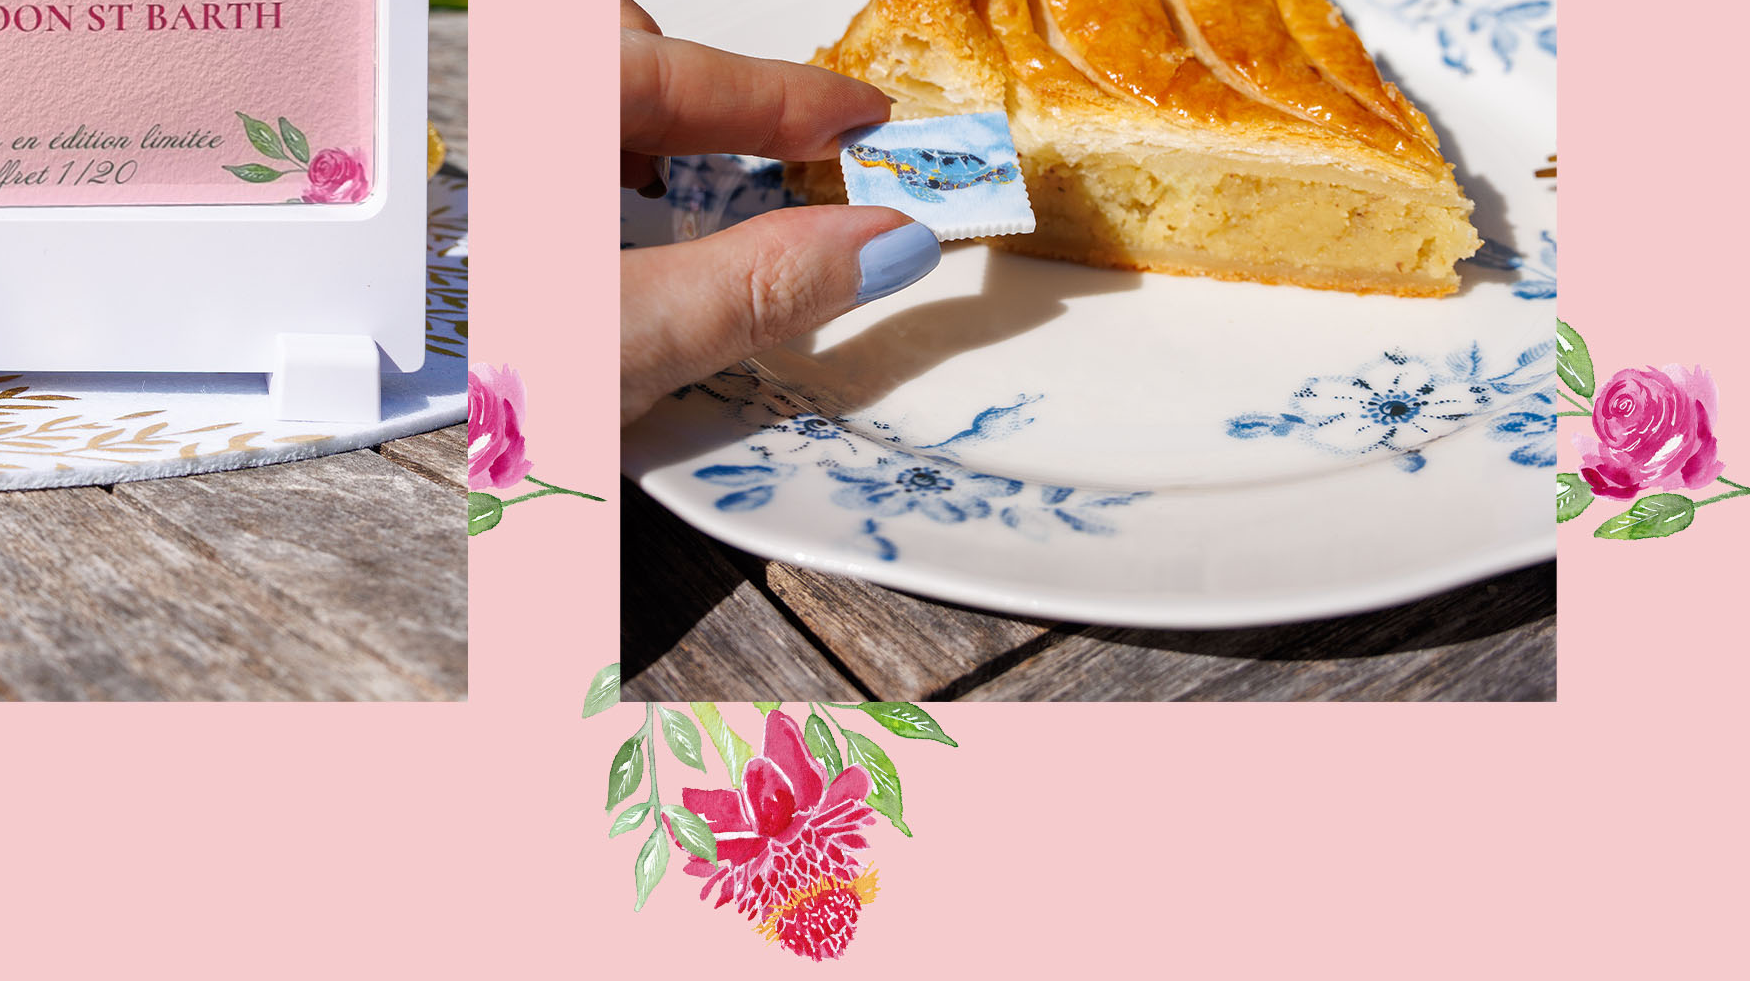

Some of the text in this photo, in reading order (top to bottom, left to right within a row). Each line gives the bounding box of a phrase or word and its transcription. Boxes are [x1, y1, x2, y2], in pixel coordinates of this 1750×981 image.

[87, 3, 134, 32] ST
[146, 2, 284, 31] BARTH
[11, 136, 40, 150] en
[49, 124, 132, 150] édition
[140, 124, 225, 150] limitée
[57, 159, 138, 186] 1/20
